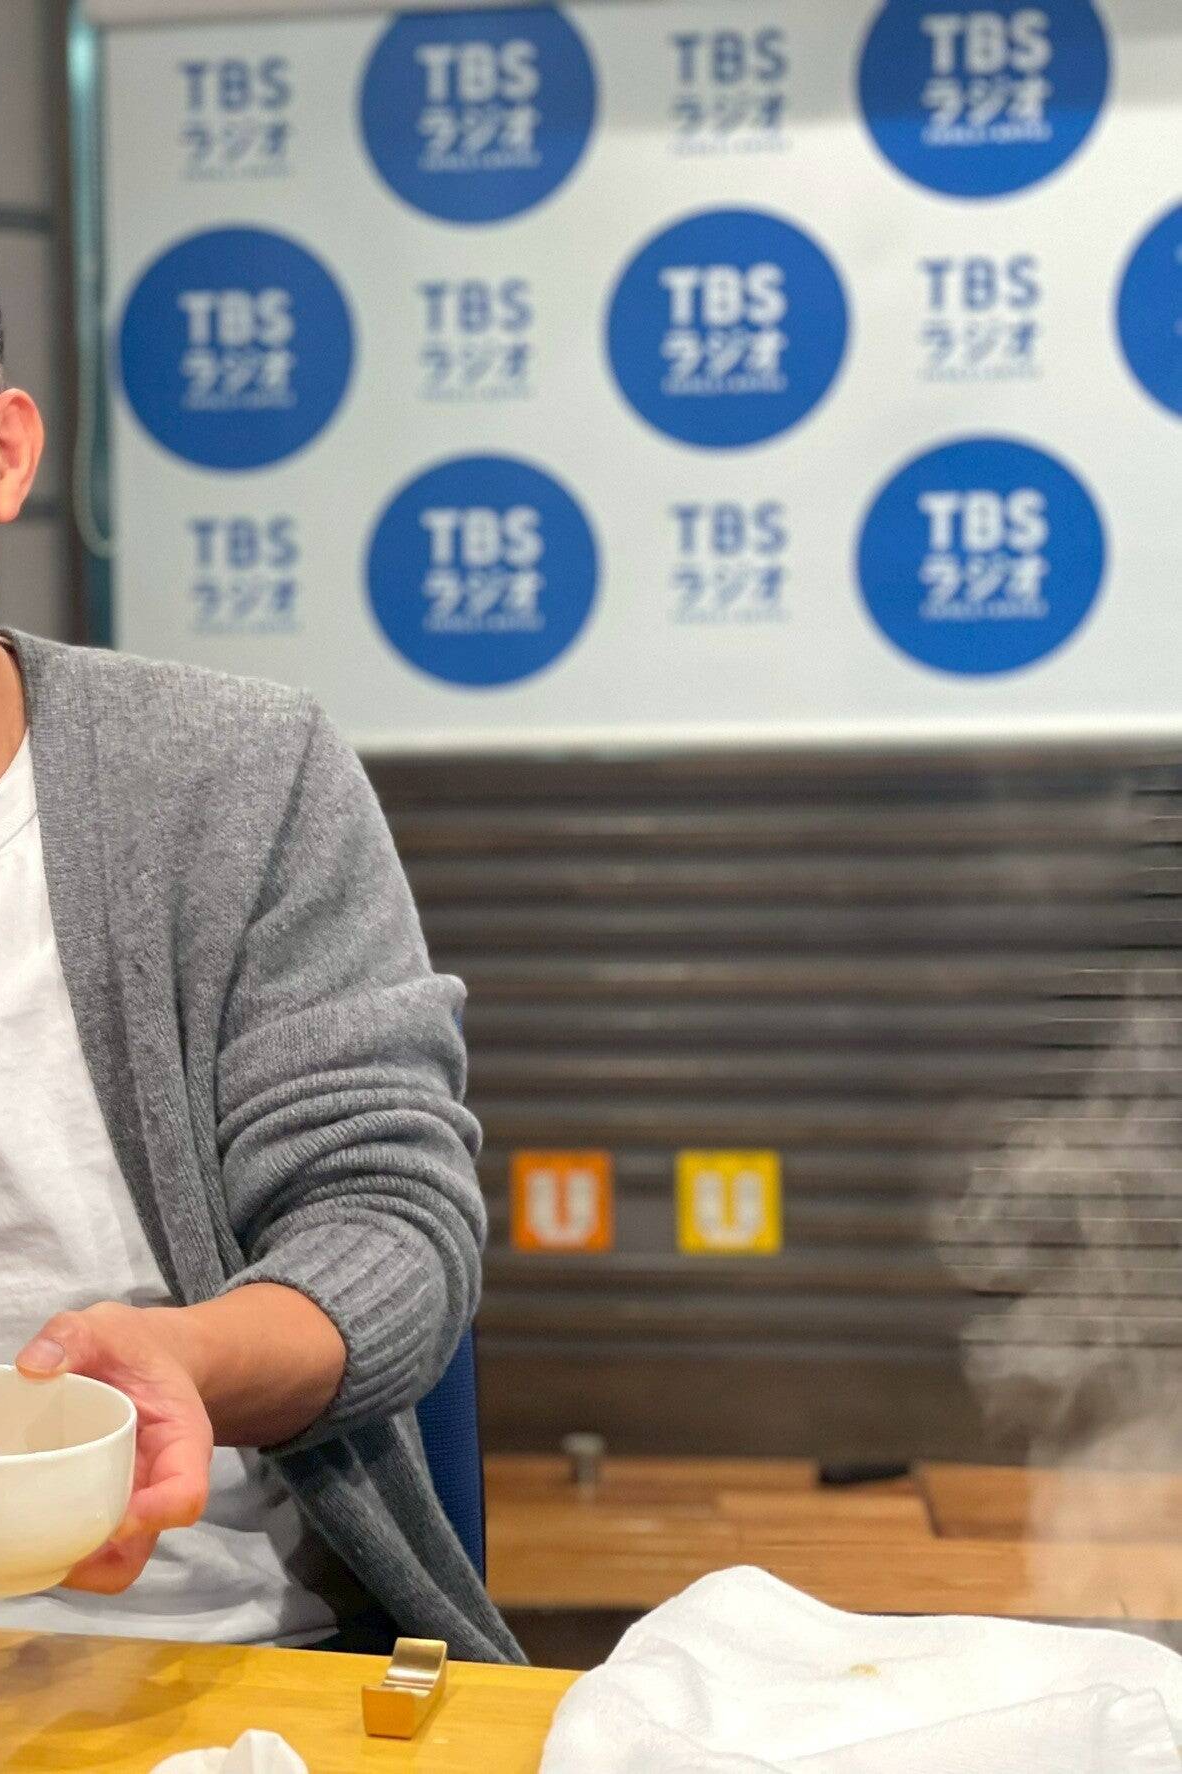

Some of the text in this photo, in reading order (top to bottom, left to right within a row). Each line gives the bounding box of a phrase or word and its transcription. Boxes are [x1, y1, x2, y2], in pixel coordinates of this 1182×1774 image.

[670, 26, 789, 87] TBS
[922, 10, 1051, 75] TBS
[179, 57, 291, 113] TBS
[417, 40, 539, 104] TBS
[672, 92, 789, 136] ラジオ
[924, 76, 1050, 126] ラジオ
[182, 119, 290, 165] ラジオ
[420, 107, 537, 157] ラジオ
[415, 278, 533, 336] TBS
[661, 263, 786, 328] TBS
[920, 255, 1041, 313] TBS
[181, 289, 294, 347] TBS
[922, 320, 1039, 365] ラジオ
[184, 349, 295, 395] ラジオ
[420, 341, 532, 385] ラジオ
[663, 329, 786, 376] ラジオ
[186, 516, 299, 571] TBS
[422, 506, 543, 568] TBS
[670, 501, 788, 557] TBS
[919, 489, 1048, 554] TBS
[192, 577, 297, 620] ラジオ
[425, 570, 543, 616] ラジオ
[672, 562, 788, 606] ラジオ
[921, 555, 1047, 604] ラジオ
[525, 1166, 599, 1245] U
[693, 1170, 765, 1247] U
